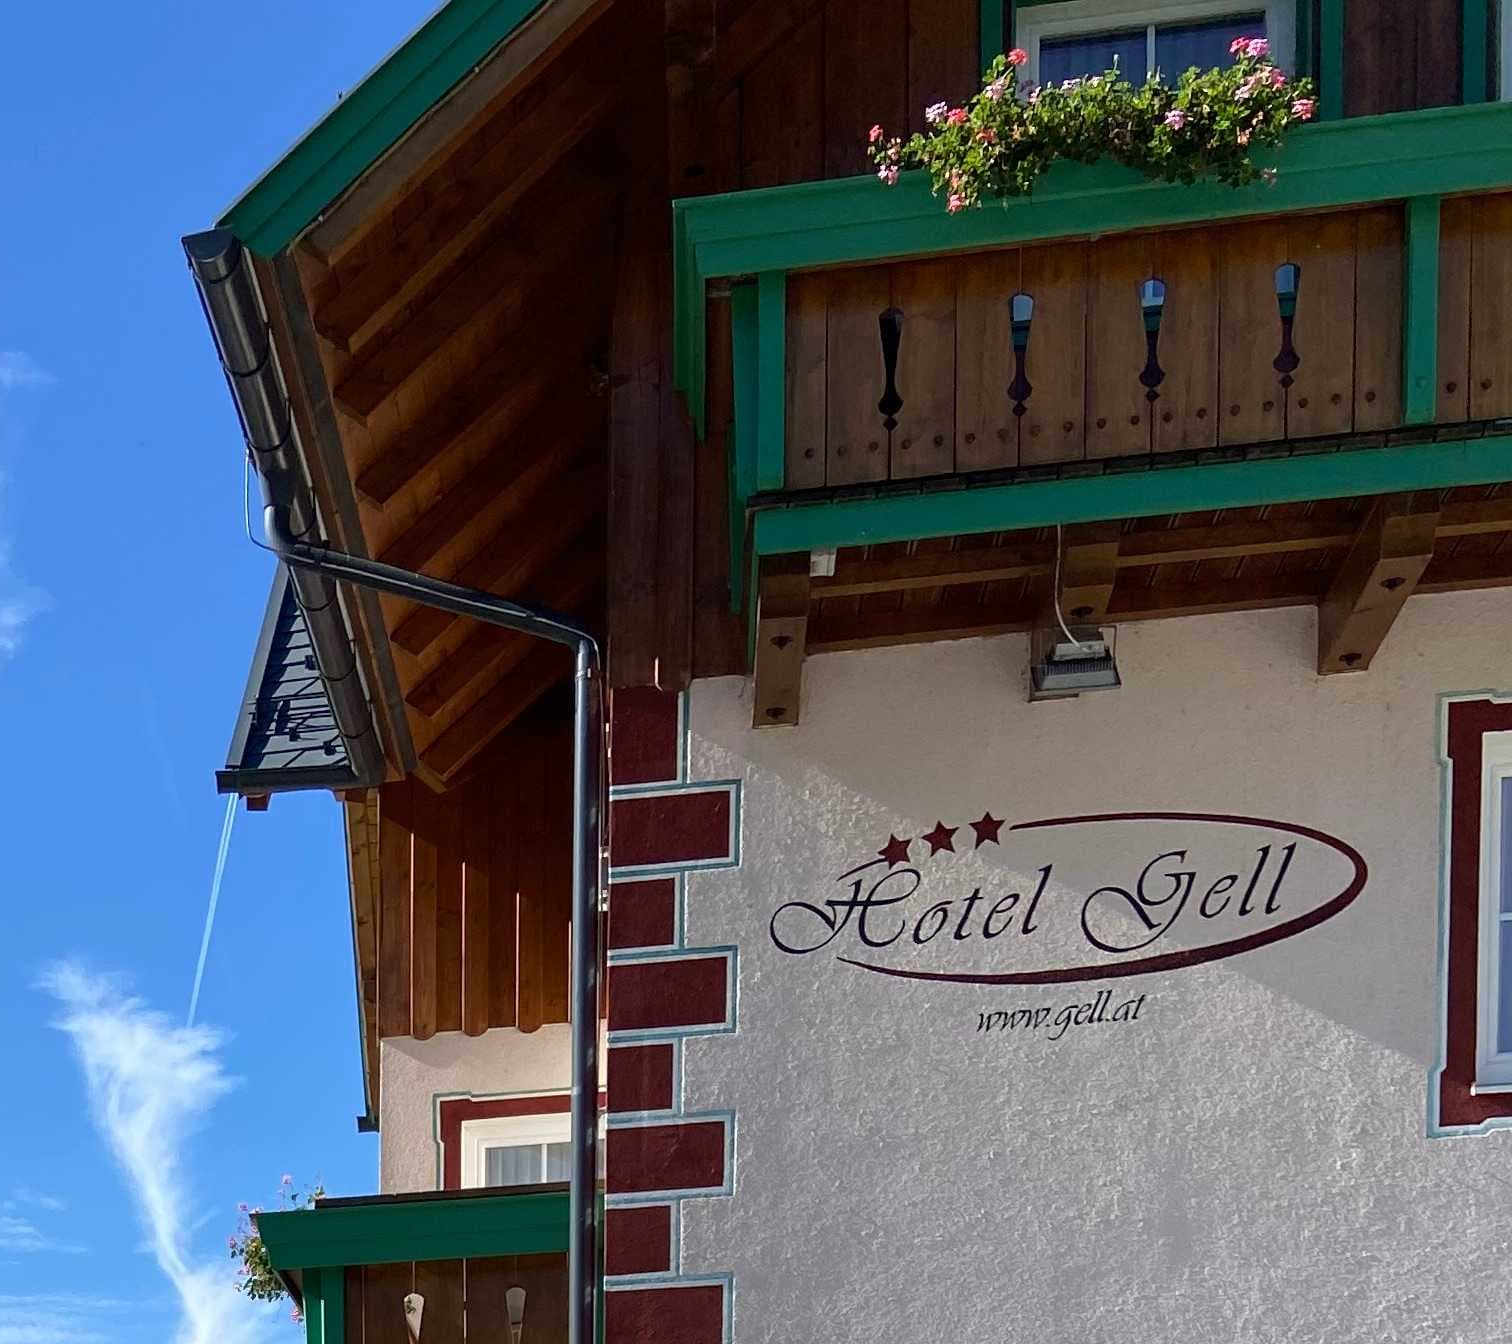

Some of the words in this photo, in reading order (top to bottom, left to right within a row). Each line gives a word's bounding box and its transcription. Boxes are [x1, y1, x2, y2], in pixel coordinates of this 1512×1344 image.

[769, 863, 1053, 955] Hotel
[1080, 842, 1298, 954] Gell
[976, 989, 1146, 1041] www.gell.at
